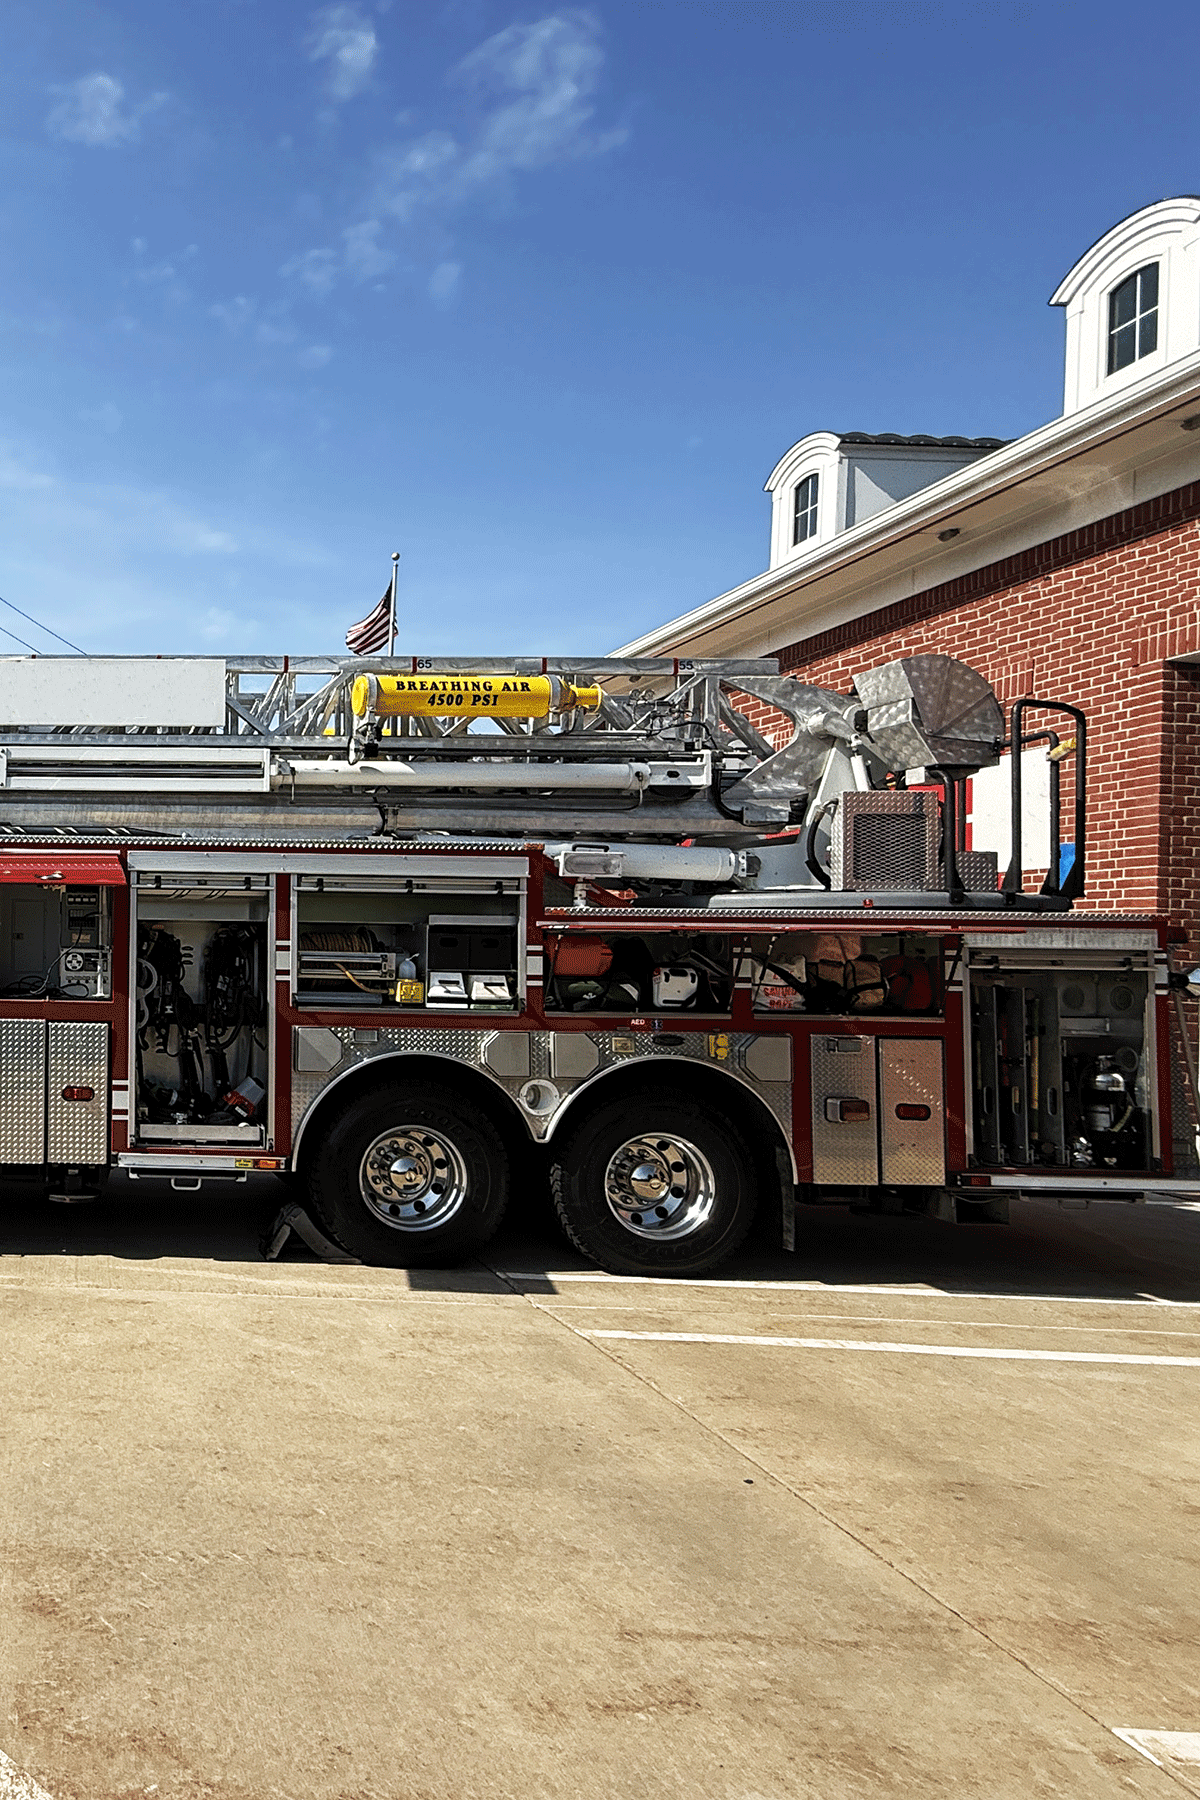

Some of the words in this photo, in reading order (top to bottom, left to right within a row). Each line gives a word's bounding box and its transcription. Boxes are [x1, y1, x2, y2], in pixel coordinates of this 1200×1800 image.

[417, 659, 432, 669] 65
[679, 660, 694, 670] 55
[396, 680, 493, 692] BREATHING
[501, 681, 531, 692] AIR
[427, 693, 464, 706] 4500
[471, 694, 498, 706] PSI
[630, 1018, 646, 1026] AED
